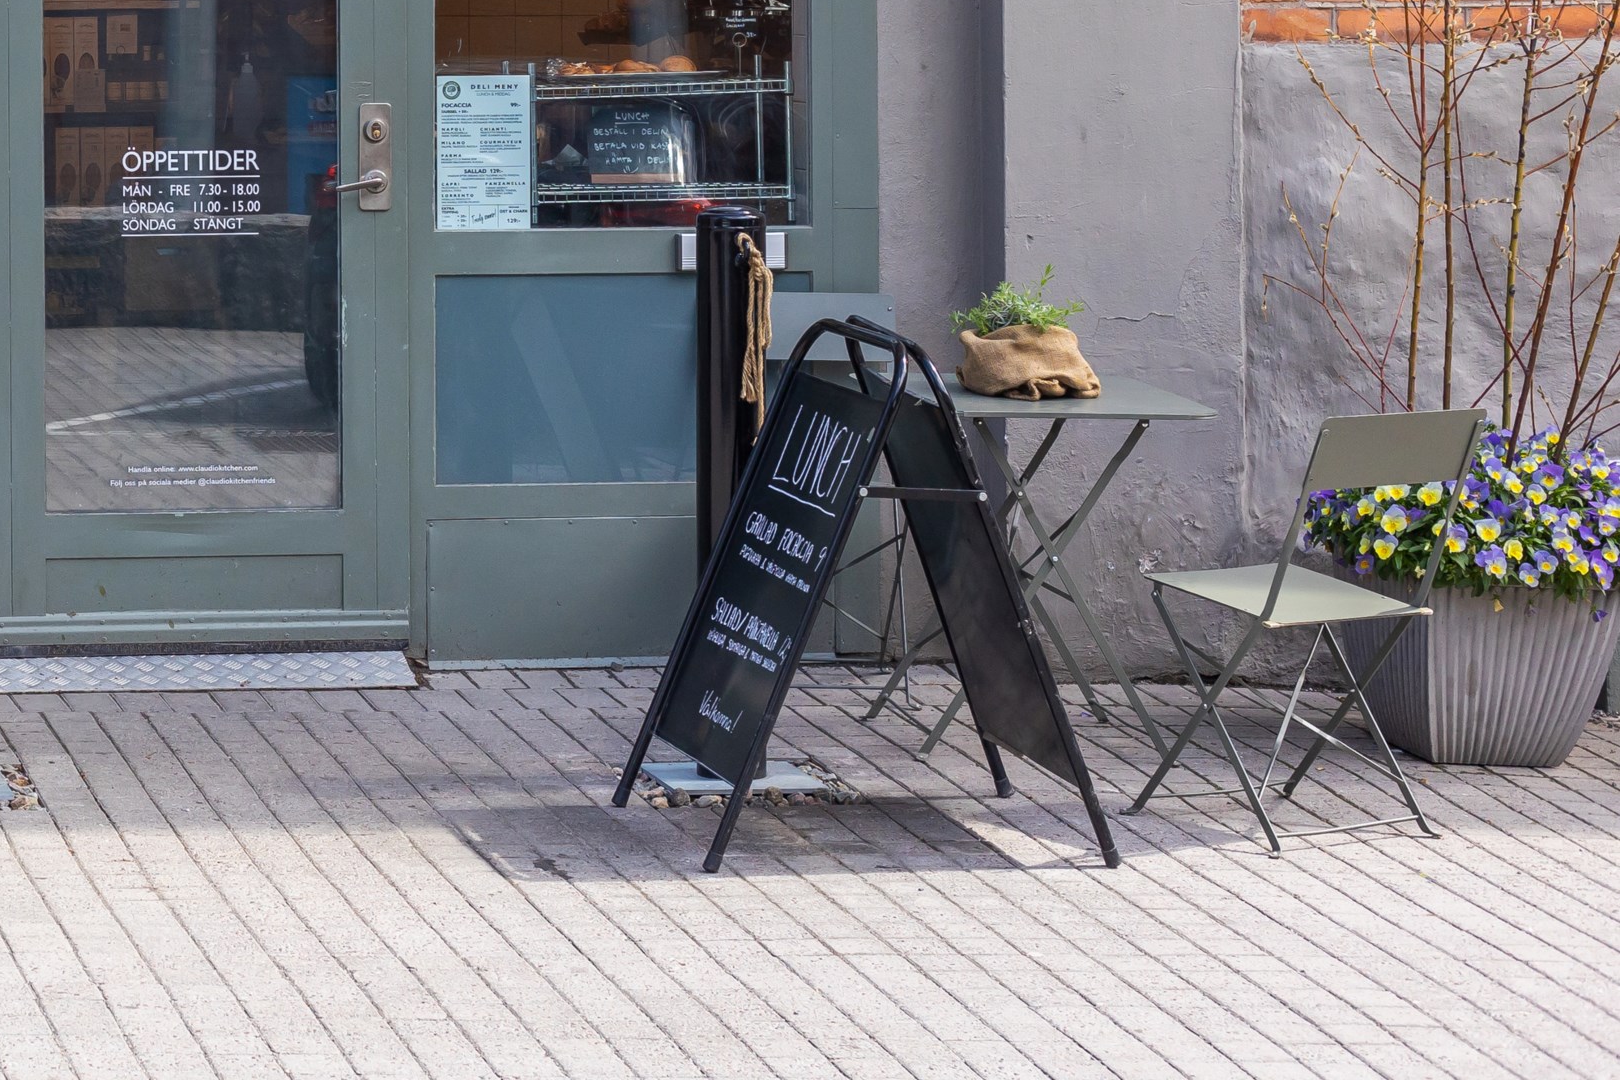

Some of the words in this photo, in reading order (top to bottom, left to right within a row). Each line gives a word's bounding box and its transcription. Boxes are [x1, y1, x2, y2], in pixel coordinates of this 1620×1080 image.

[615, 112, 650, 120] LUNCH
[122, 146, 260, 172] ÖPPETTIDER
[122, 182, 151, 197] MÅN
[170, 184, 191, 196] FRE
[199, 184, 221, 196] 7.30
[232, 184, 260, 196] 18.00
[122, 200, 174, 214] LÖRDAG
[193, 201, 221, 213] 11.00
[232, 200, 261, 212] 15.00
[122, 216, 176, 231] SÖNDAG
[194, 216, 244, 230] STÄNGT
[772, 404, 862, 504] LUNCH
[110, 479, 123, 488] Följ
[138, 479, 147, 487] på
[198, 477, 276, 487] @claudiokitchenfriends
[746, 511, 778, 545] GRILLAD
[777, 528, 814, 564] FOCACCIA
